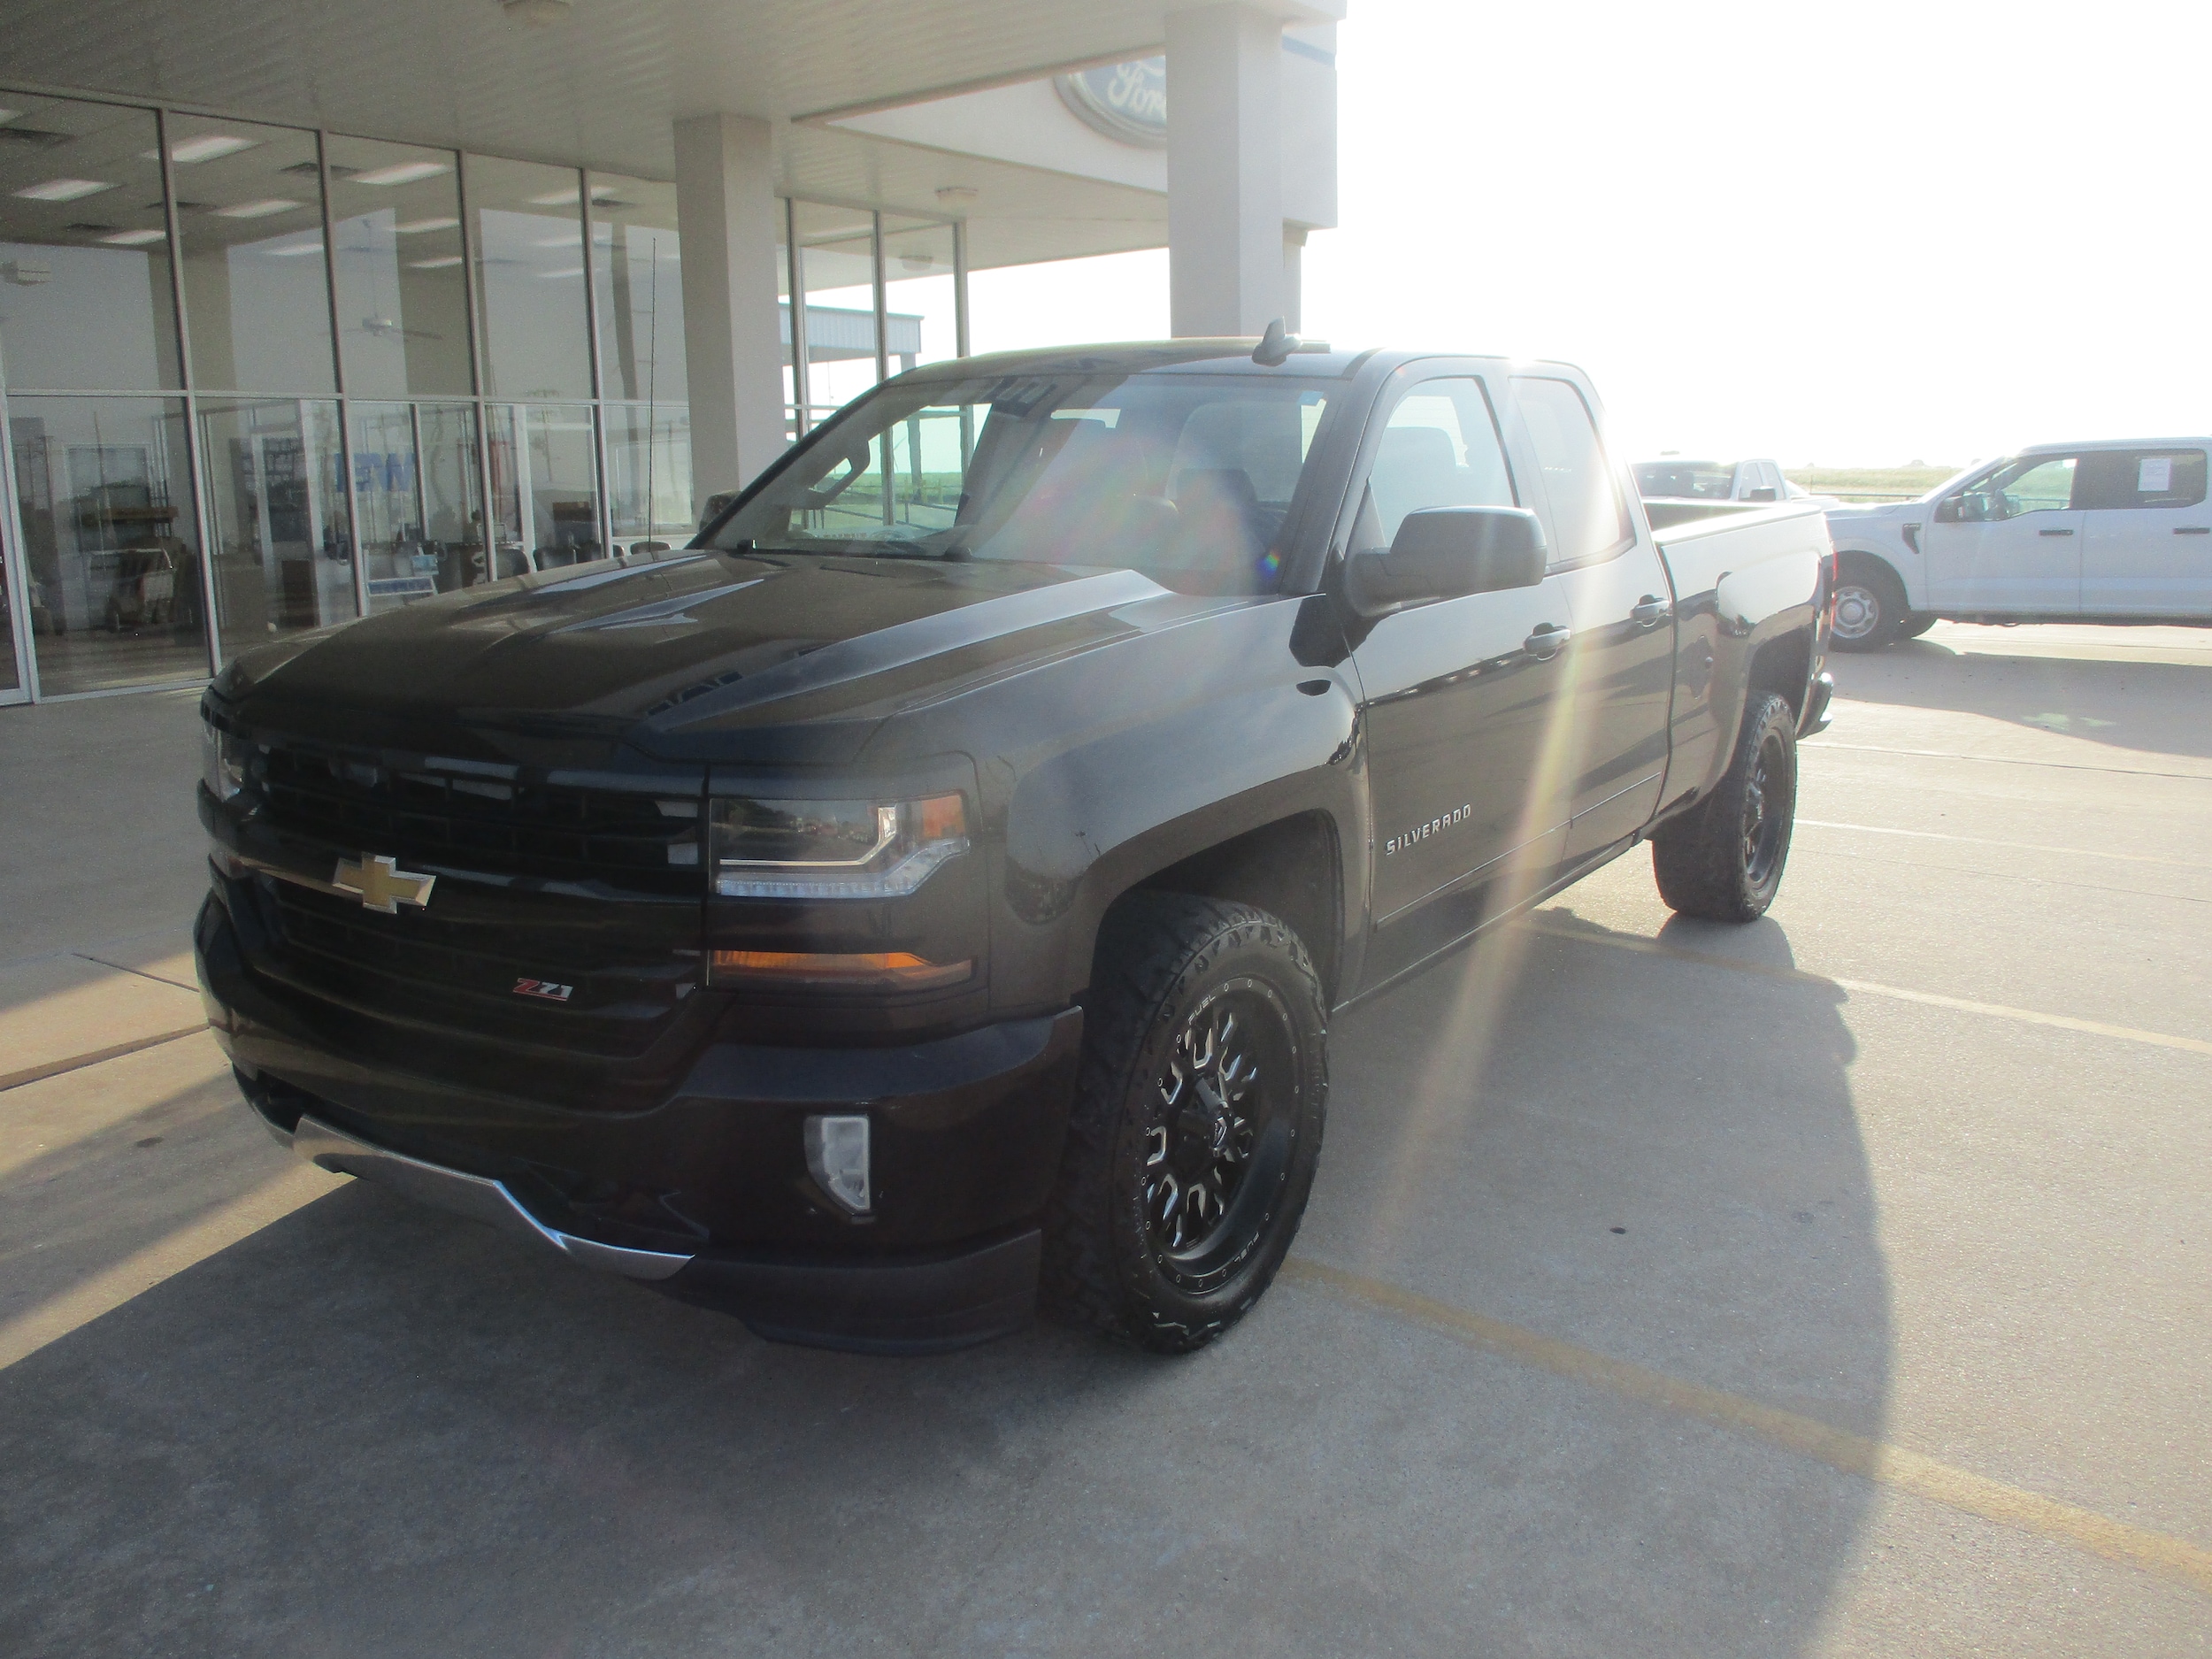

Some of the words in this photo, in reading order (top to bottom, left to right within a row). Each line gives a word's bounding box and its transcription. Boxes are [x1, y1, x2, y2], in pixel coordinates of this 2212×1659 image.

[1108, 59, 1166, 119] For
[1386, 803, 1471, 856] SILVERADO
[513, 977, 573, 1002] Z71
[1187, 995, 1217, 1025] FUEL
